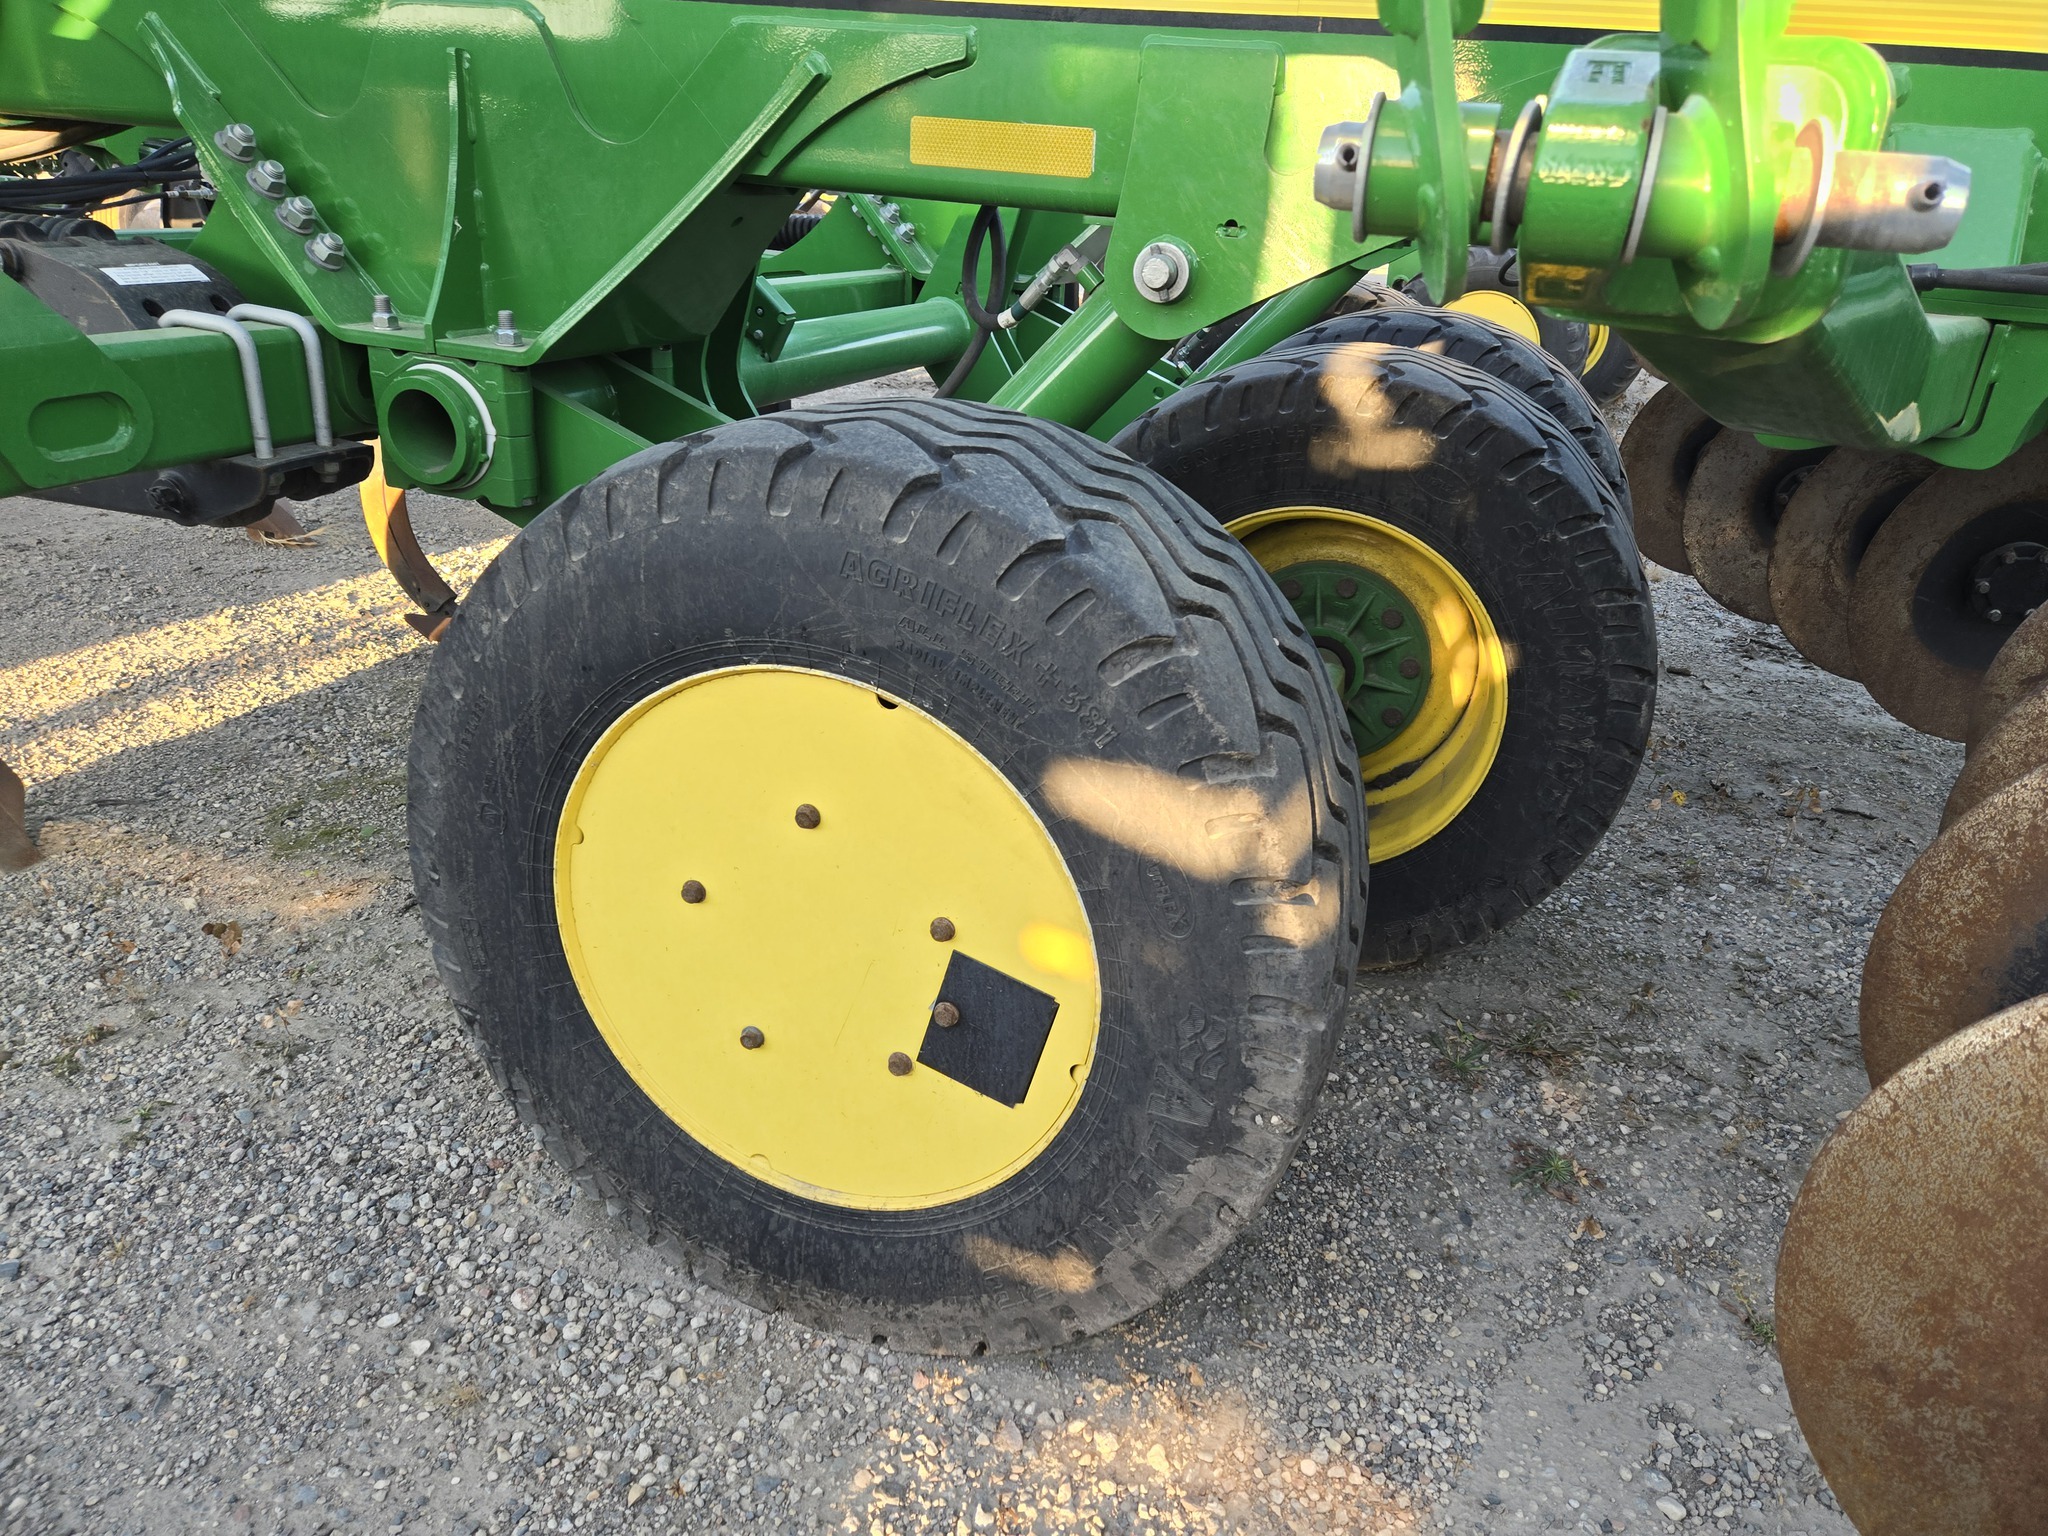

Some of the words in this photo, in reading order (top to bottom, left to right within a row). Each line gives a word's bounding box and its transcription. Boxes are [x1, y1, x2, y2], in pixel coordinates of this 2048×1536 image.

[840, 550, 1036, 668] AGRIFLEX
[1059, 685, 1121, 750] 381
[898, 615, 949, 651] ALL
[959, 648, 1037, 716] STEEL
[981, 1062, 1216, 1309] ALLIANCE
